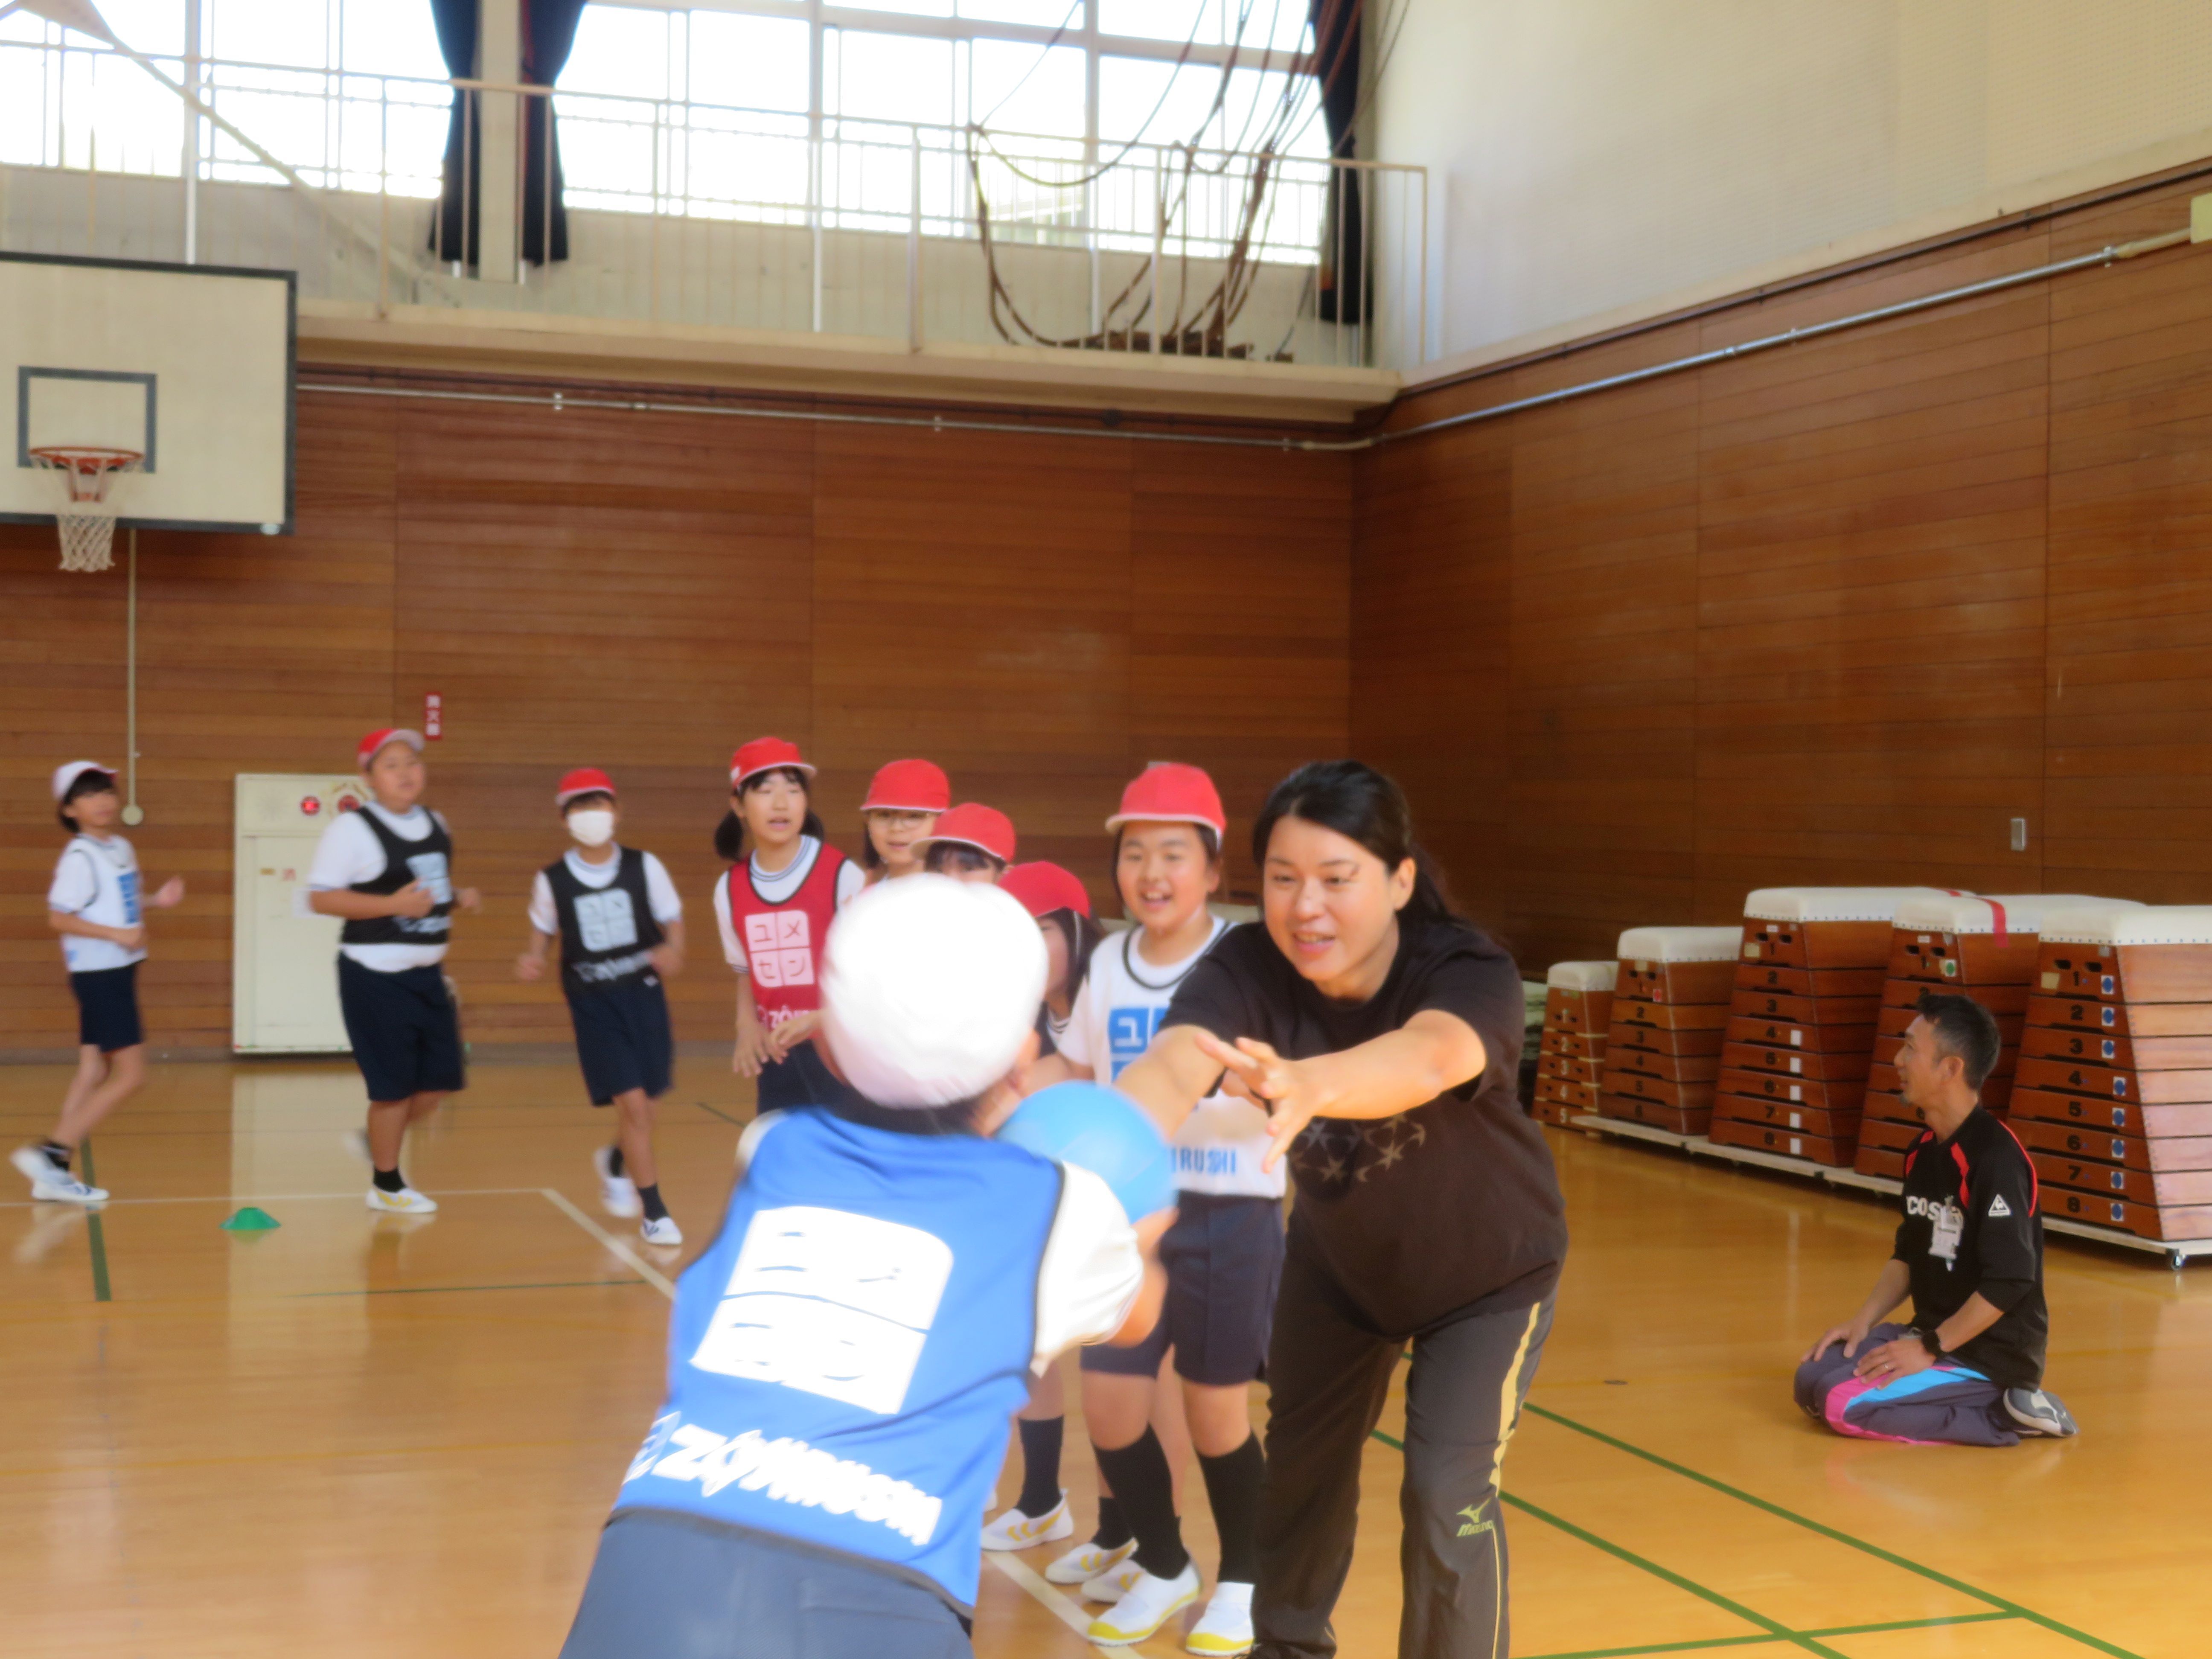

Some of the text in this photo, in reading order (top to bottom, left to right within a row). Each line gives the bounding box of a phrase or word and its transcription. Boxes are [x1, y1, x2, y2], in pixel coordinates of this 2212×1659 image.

[2073, 971, 2078, 986] 1
[2071, 1004, 2083, 1020] 2
[2071, 1039, 2082, 1054] 3
[2069, 1071, 2081, 1085] 4
[1765, 1105, 1775, 1118] 7
[2069, 1101, 2081, 1117] 5
[2067, 1135, 2080, 1150] 6
[2068, 1165, 2081, 1180] 7
[2067, 1197, 2080, 1213] 8
